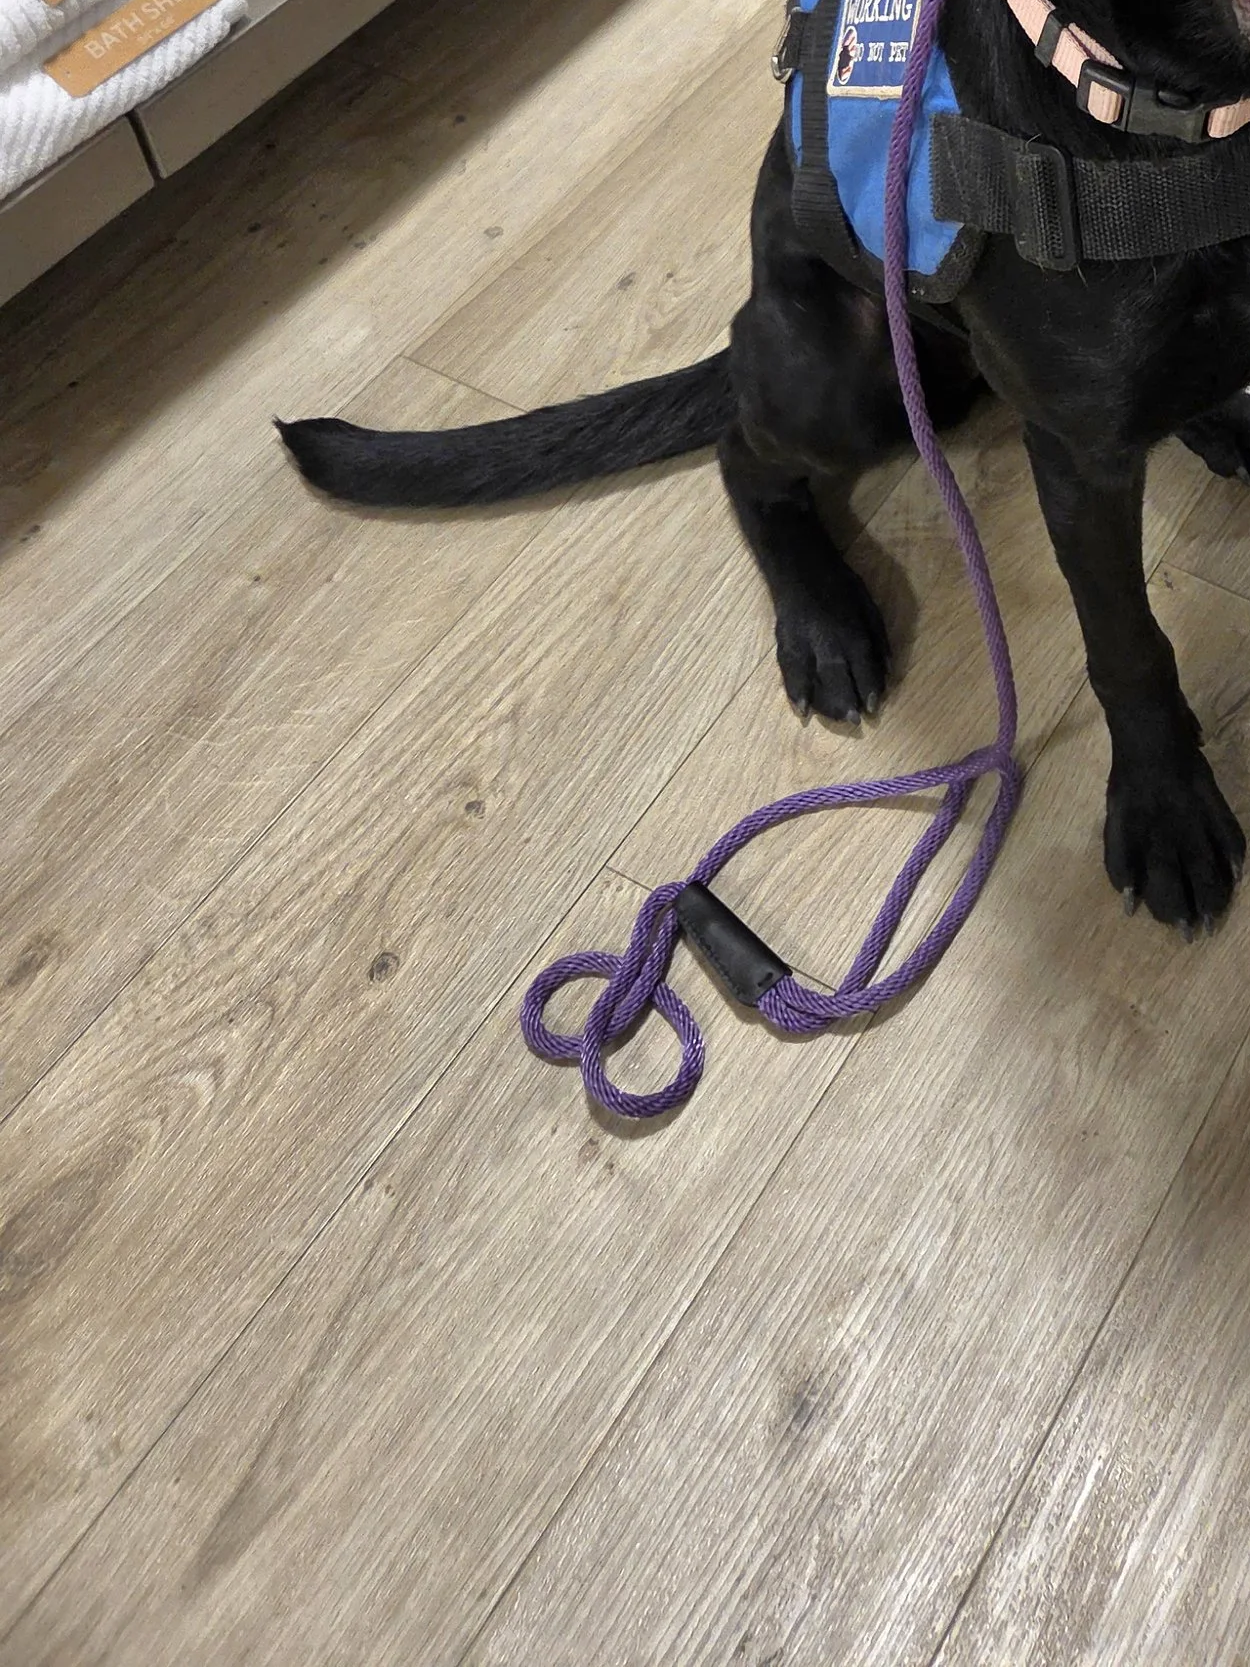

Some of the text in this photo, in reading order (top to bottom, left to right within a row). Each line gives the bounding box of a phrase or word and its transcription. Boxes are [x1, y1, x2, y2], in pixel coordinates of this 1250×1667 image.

[84, 12, 145, 60] BATH
[867, 41, 885, 63] NOT
[888, 41, 909, 63] PET
